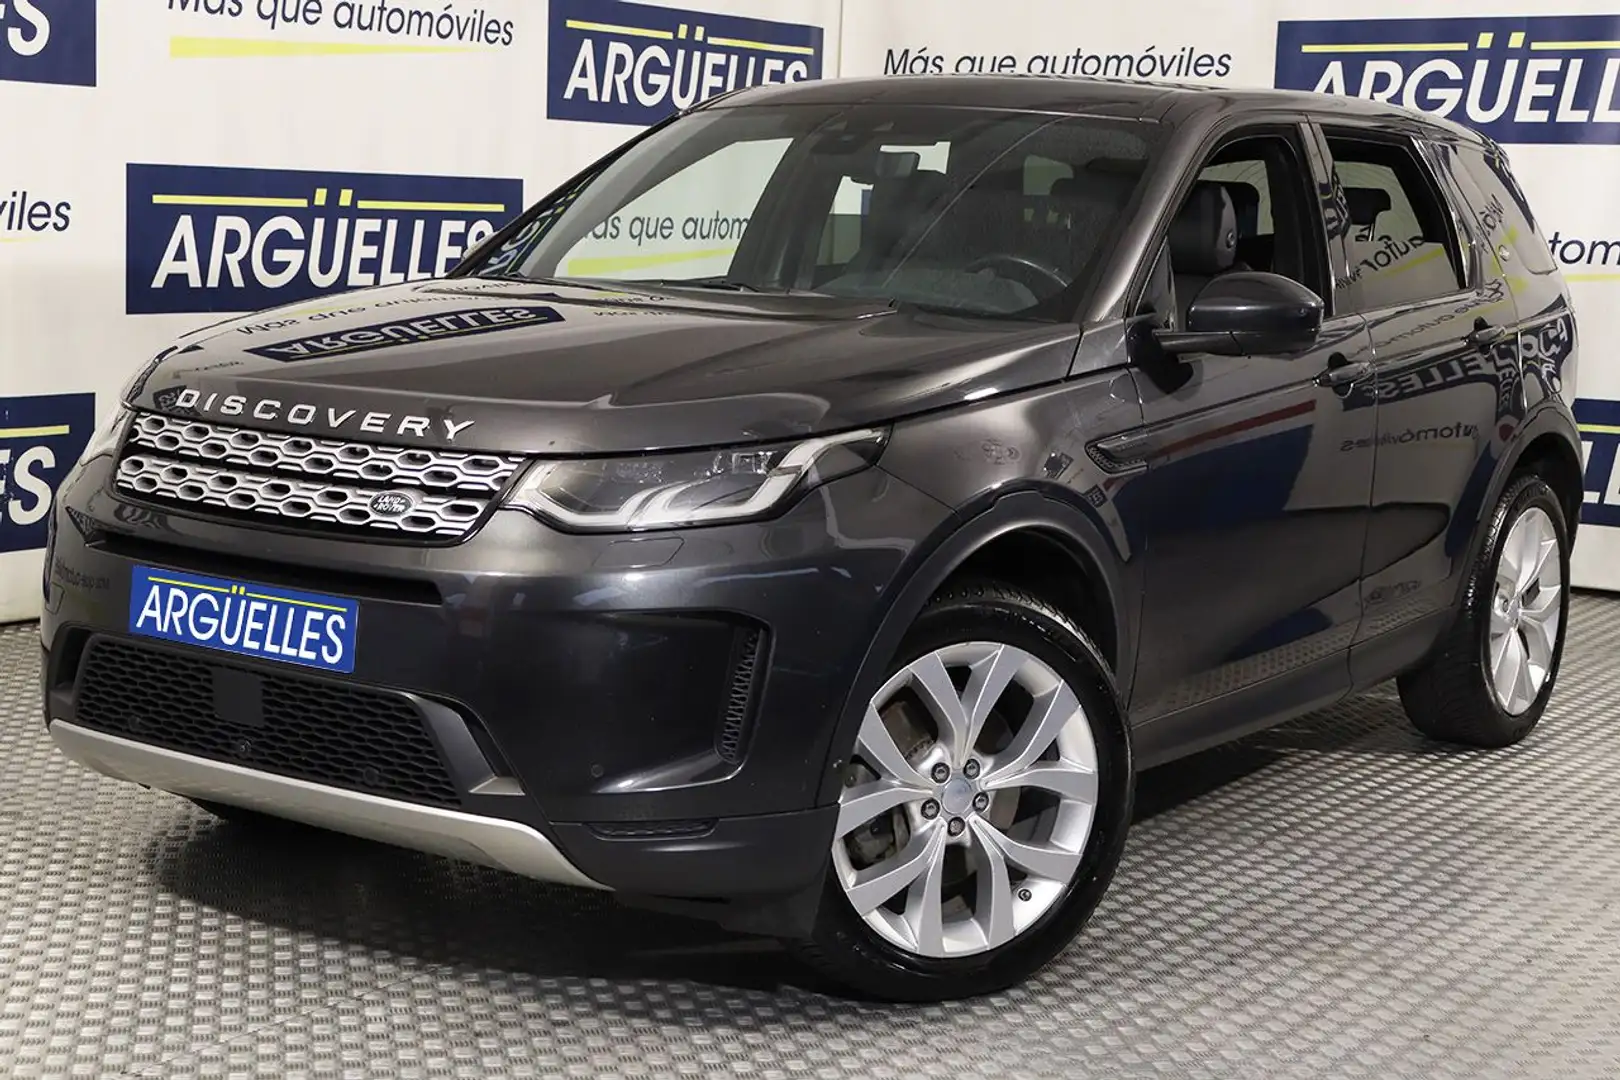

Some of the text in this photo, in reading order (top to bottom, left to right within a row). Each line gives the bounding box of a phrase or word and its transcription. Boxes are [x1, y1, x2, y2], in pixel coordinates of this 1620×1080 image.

[333, 0, 514, 46] automóviles
[1027, 46, 1232, 78] automóviles
[629, 216, 675, 246] que
[175, 388, 474, 441] DISCOVERY
[136, 584, 347, 664] ARGÜELLES
